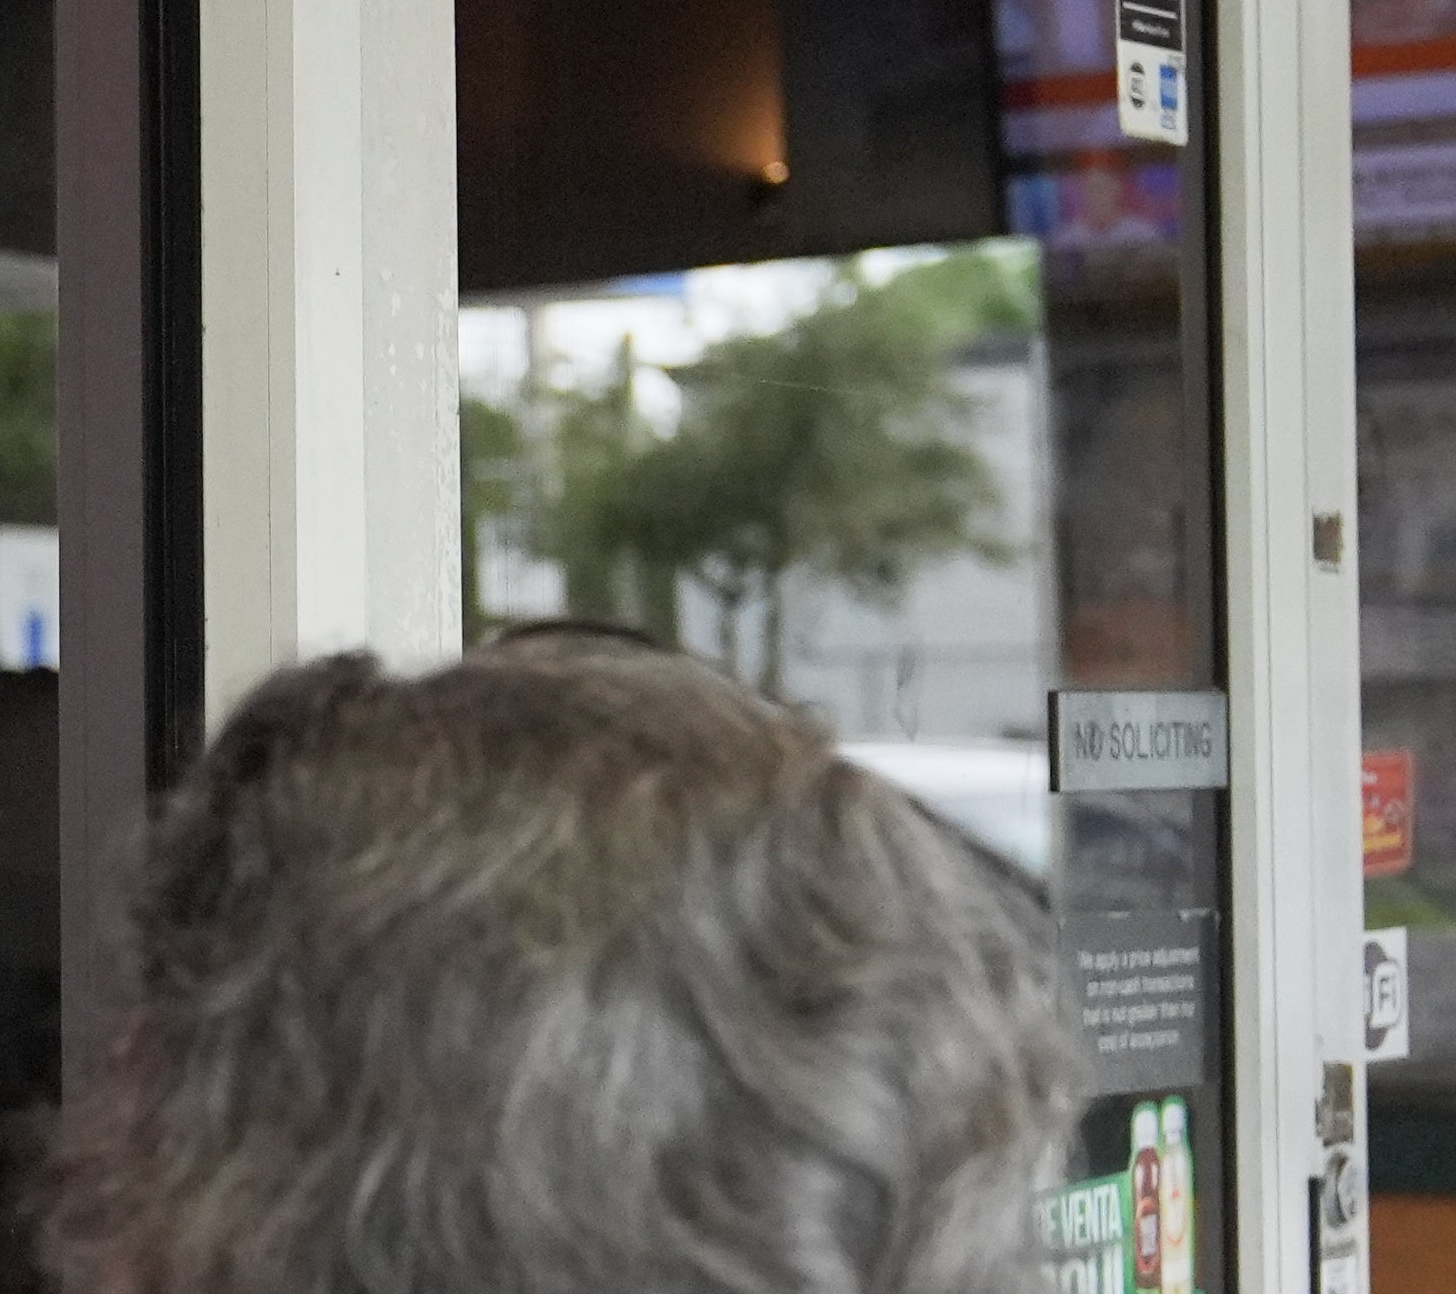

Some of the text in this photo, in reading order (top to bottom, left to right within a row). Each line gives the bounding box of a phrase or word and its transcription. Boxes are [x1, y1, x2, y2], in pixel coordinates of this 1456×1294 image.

[1073, 719, 1214, 762] NO SOLICITING
[1059, 1182, 1124, 1251] VENTA
